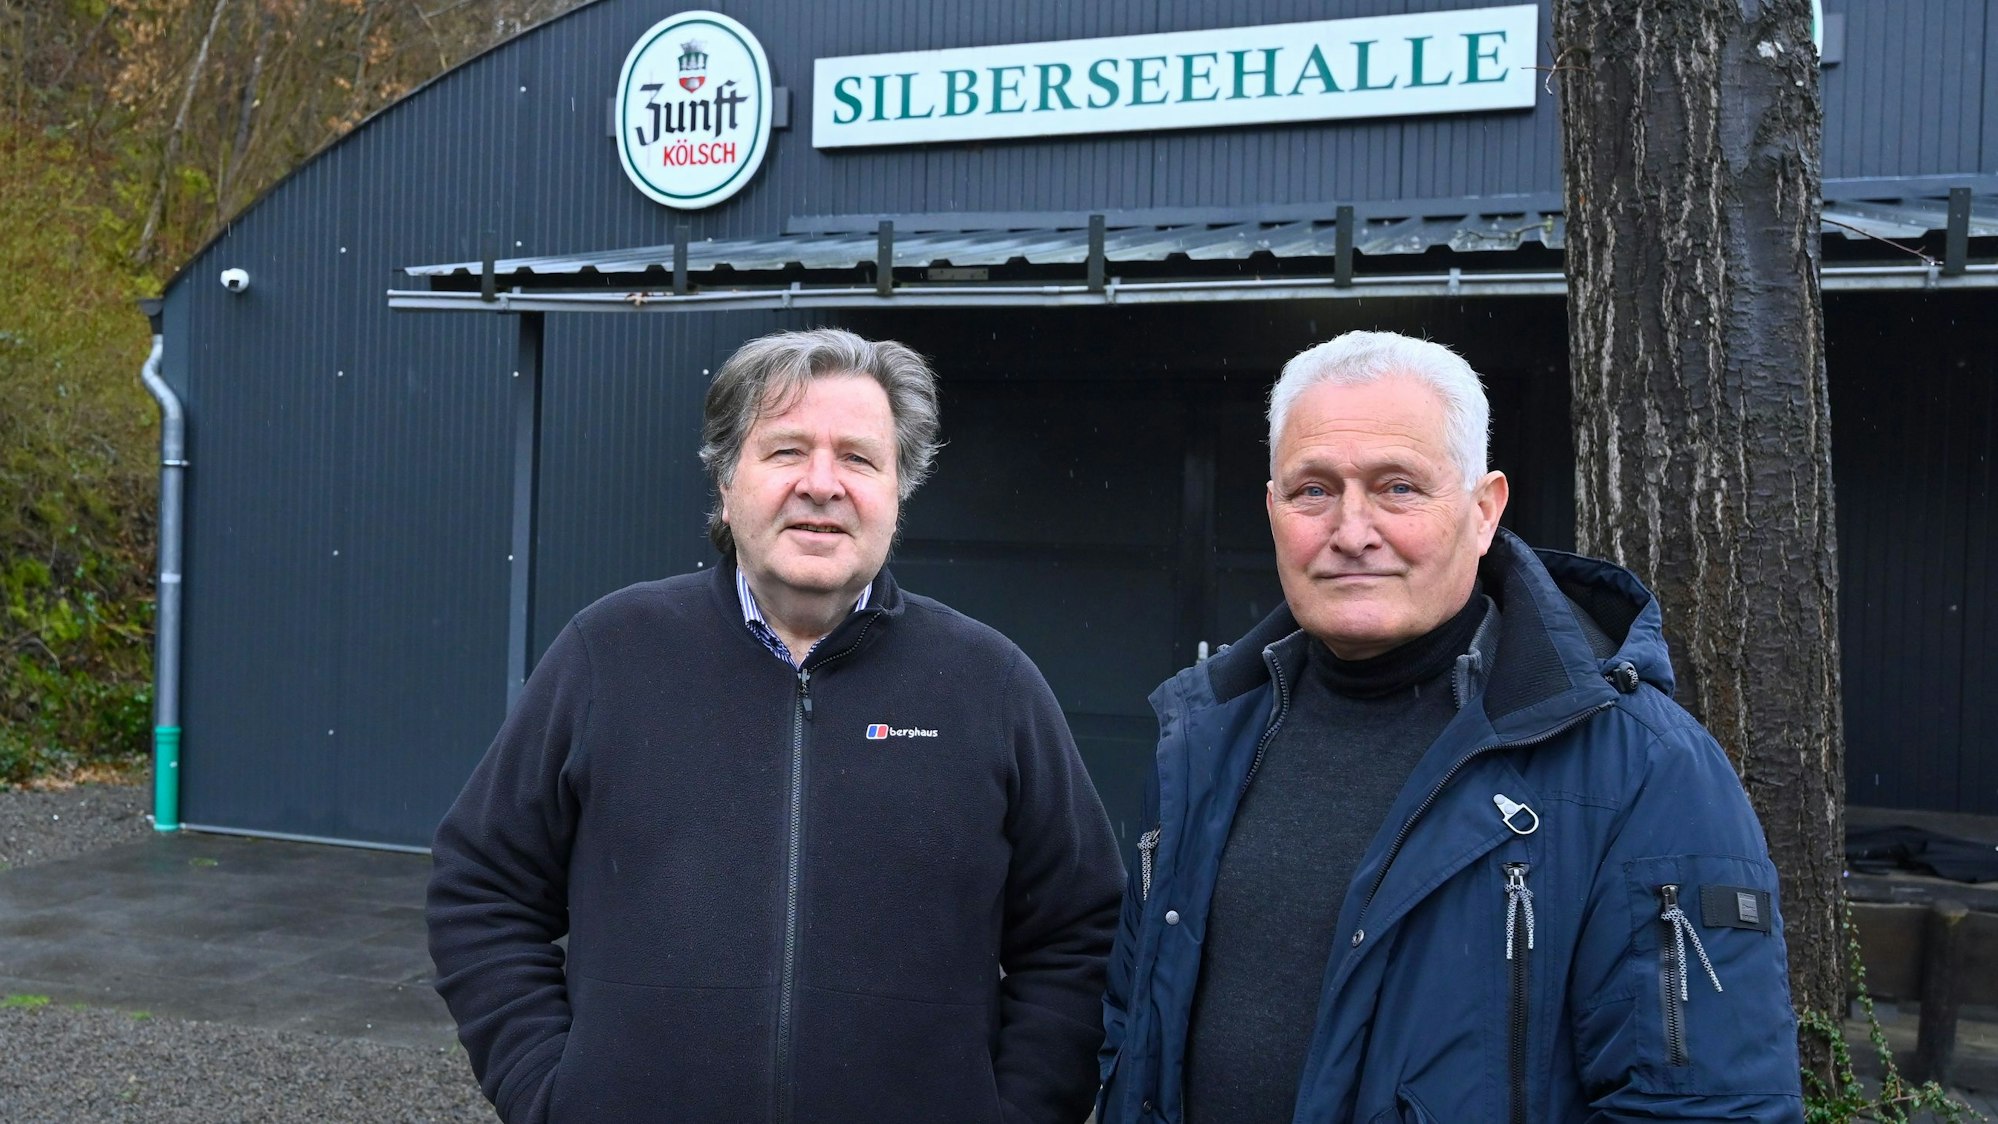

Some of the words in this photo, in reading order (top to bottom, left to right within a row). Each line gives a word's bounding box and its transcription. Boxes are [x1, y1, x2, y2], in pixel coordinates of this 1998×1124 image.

[832, 30, 1510, 126] SILBERSEEHALLE
[635, 79, 749, 147] Zunft
[663, 139, 736, 167] KÖLSCH
[889, 726, 939, 739] berghaus
